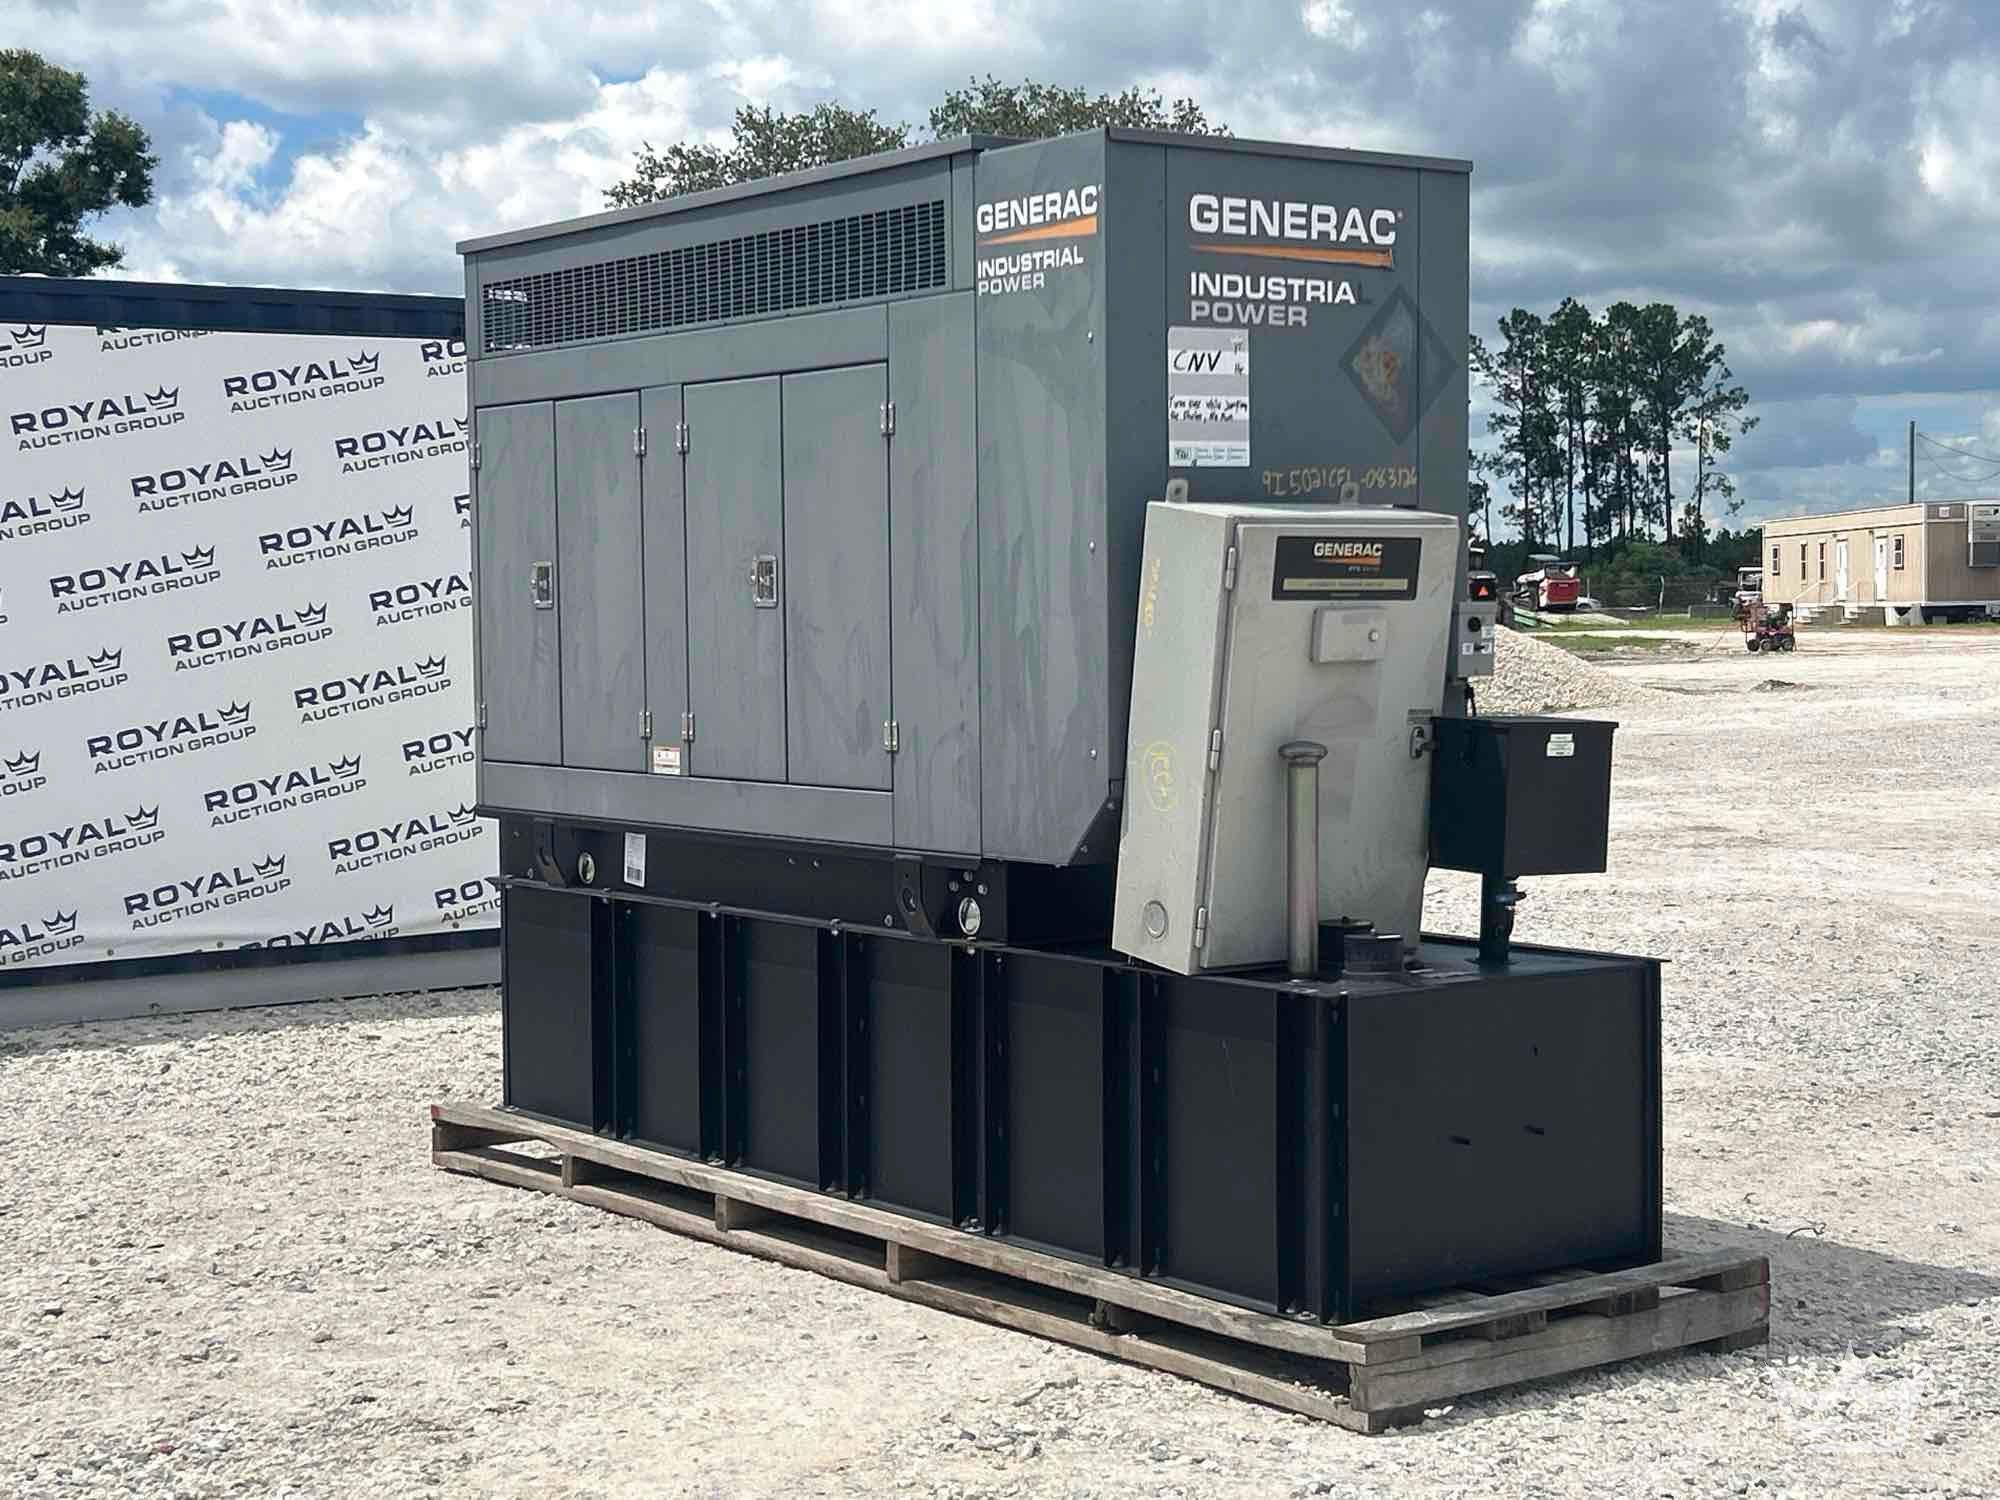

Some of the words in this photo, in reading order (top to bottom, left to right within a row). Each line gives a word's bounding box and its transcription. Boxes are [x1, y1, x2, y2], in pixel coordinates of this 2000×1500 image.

[977, 185, 1098, 232] GENERAC
[1190, 194, 1396, 245] GENERAC
[977, 245, 1084, 279] INDUSTRIAL
[978, 272, 1045, 296] POWER
[1191, 300, 1307, 327] POWER
[224, 360, 349, 397] ROYAL
[1173, 349, 1222, 372] CNV
[10, 395, 147, 434] ROYAL
[231, 388, 316, 413] AUCTION
[320, 376, 385, 397] GROUP
[18, 425, 110, 451] AUCTION
[115, 412, 185, 433] GROUP
[335, 421, 455, 458] ROYAL
[131, 457, 262, 497] ROYAL
[342, 449, 423, 474] AUCTION
[427, 441, 468, 456] GRO
[138, 487, 227, 513] AUCTION
[230, 473, 298, 496] GROUP
[18, 514, 90, 536] GROUP
[259, 515, 384, 554] ROYAL
[265, 543, 352, 570] AUCTION
[355, 529, 419, 552] GROUP
[1314, 543, 1383, 557] GENERAC
[50, 555, 183, 598] ROYAL
[57, 585, 148, 614] AUCTION
[151, 570, 221, 594] GROUP
[369, 571, 472, 611] ROYA
[377, 600, 456, 626] AUCTION
[168, 613, 297, 656] ROYAL
[175, 643, 261, 671] AUCTION
[266, 627, 333, 651] GROUP
[57, 673, 128, 698] GROUP
[295, 666, 417, 708] ROYAL
[301, 696, 384, 724] AUCTION
[388, 678, 451, 703] GROUP
[87, 712, 220, 758] ROYAL
[94, 743, 185, 775] AUCTION
[188, 726, 256, 751] GROUP
[205, 766, 330, 811] ROYAL
[211, 796, 297, 827] AUCTION
[301, 779, 367, 804] GROUP
[94, 830, 165, 857] GROUP
[329, 814, 449, 859] ROYAL
[335, 846, 417, 875] AUCTION
[420, 826, 483, 852] GROUP
[123, 866, 255, 915] ROYAL
[132, 898, 220, 930] AUCTION
[223, 878, 291, 906] GROUP
[12, 935, 84, 962] GROUP
